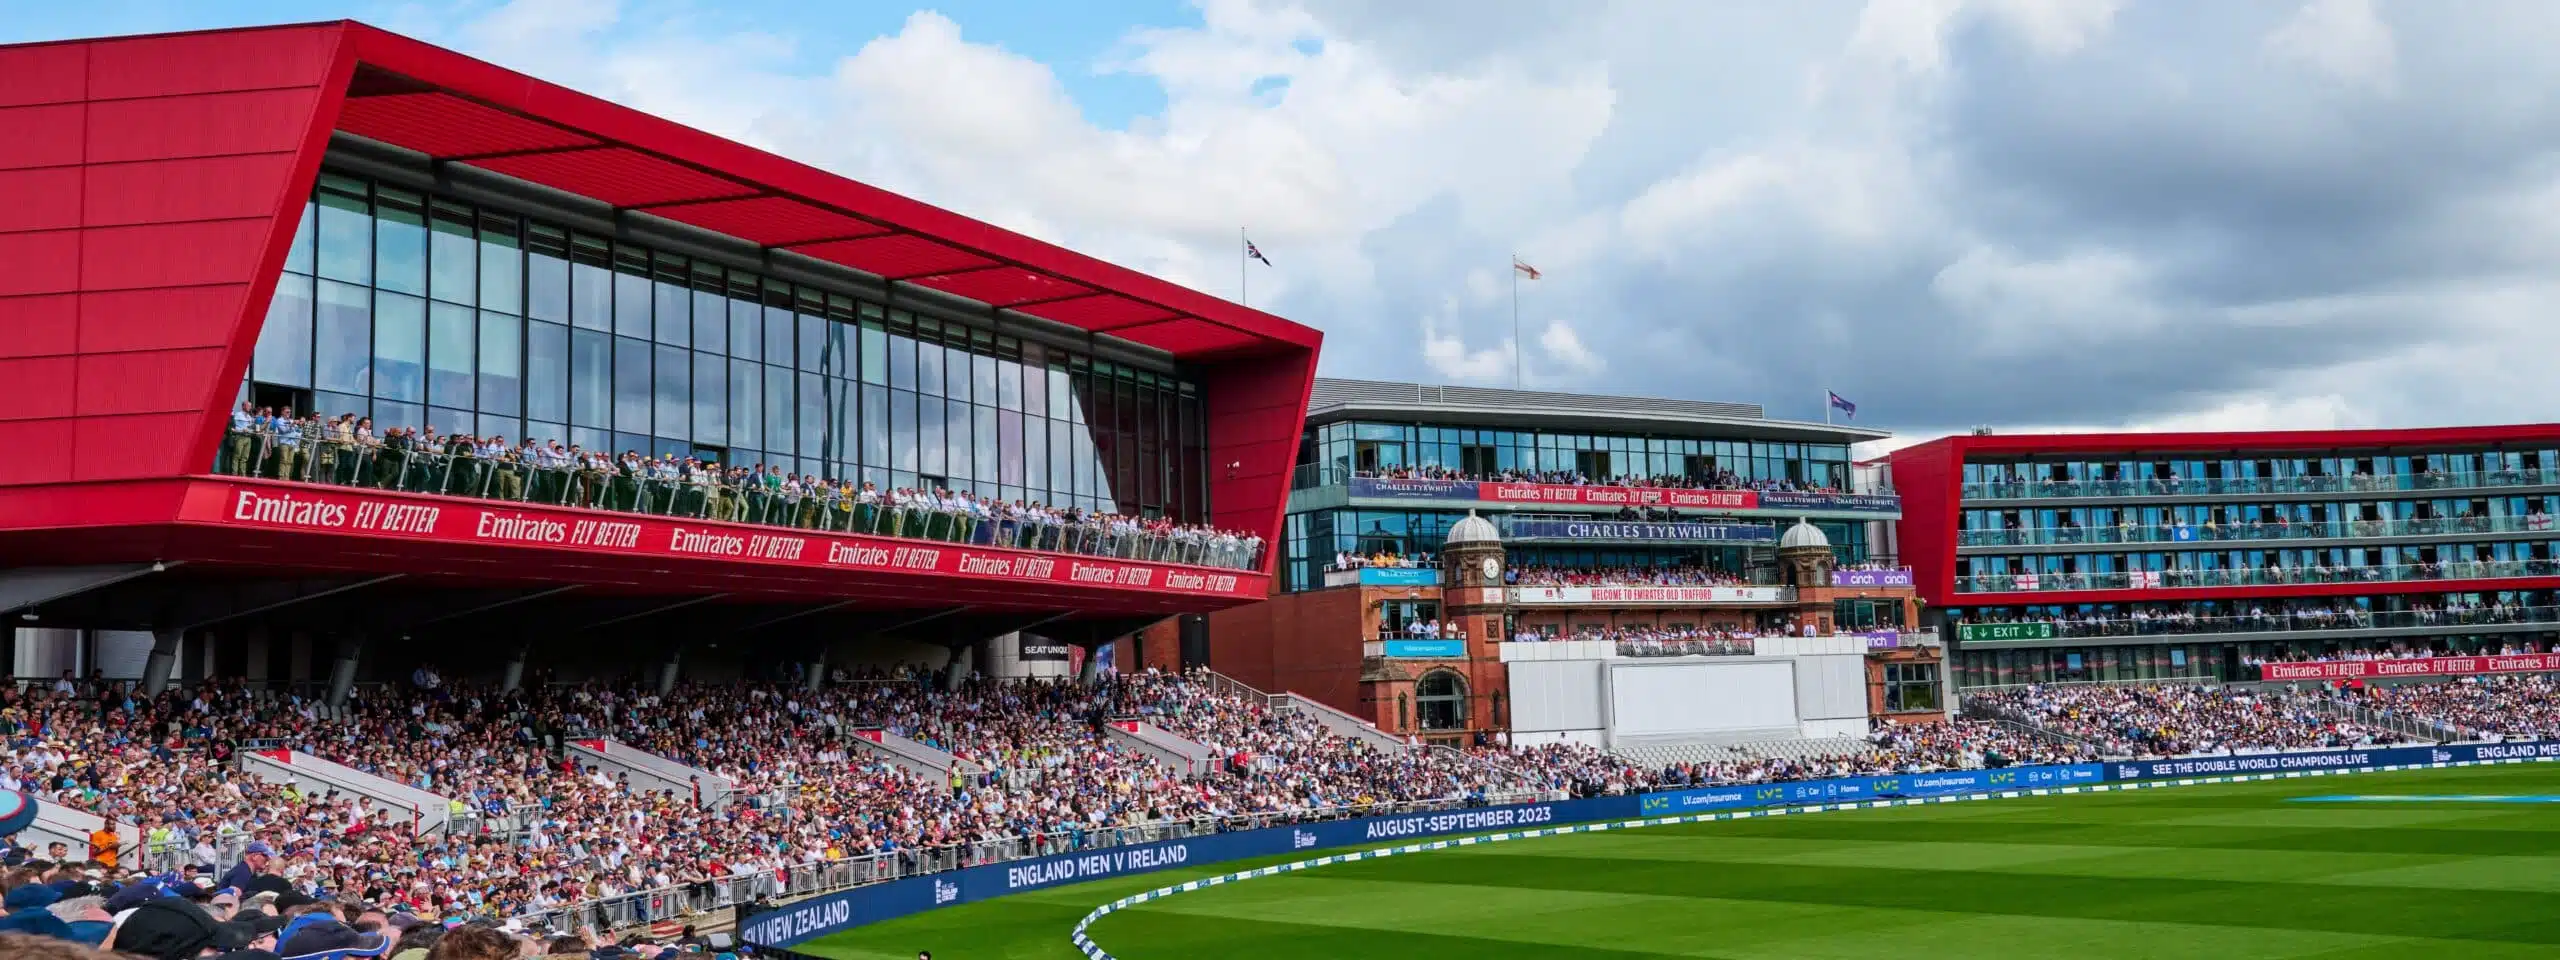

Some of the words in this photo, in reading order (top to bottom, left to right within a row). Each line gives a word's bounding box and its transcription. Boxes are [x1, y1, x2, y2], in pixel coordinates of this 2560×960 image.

[1498, 486, 1540, 500] Emirates
[1543, 488, 1554, 500] FLY
[1555, 488, 1577, 501] BETTER
[1586, 489, 1627, 502] Emirates
[1629, 490, 1640, 502] FLY
[1671, 492, 1709, 505] Emirates
[1722, 494, 1742, 506] BETTER
[234, 490, 347, 527] Emirates
[352, 501, 384, 529] FLY
[381, 504, 440, 533] BETTER
[476, 511, 567, 543] Emirates
[570, 519, 598, 545] FLY
[594, 522, 641, 548] BETTER
[1567, 524, 1640, 538] CHARLES
[1646, 525, 1728, 539] TYRWHITT
[670, 527, 744, 556] Emirates
[746, 534, 769, 557] FLY
[765, 536, 805, 560] BETTER
[828, 541, 888, 566] Emirates
[891, 547, 908, 567] FLY
[906, 548, 940, 570] BETTER
[958, 552, 1011, 576] Emirates
[1012, 556, 1029, 577] FLY
[1025, 558, 1055, 579] BETTER
[1070, 562, 1115, 584] Emirates
[1116, 566, 1129, 584] FLY
[1127, 567, 1152, 586] BETTER
[1166, 570, 1204, 590] Emirates
[1205, 574, 1218, 591] FLY
[1215, 575, 1237, 592] BETTER
[1850, 574, 1875, 584] cinch
[1884, 574, 1908, 584] cinch
[1591, 589, 1622, 601] WELCOME
[1623, 589, 1632, 601] TO
[1633, 589, 1665, 601] EMIRATES
[1666, 589, 1679, 601] OLD
[1680, 589, 1712, 601] TRAFFORD
[1993, 626, 2020, 638] EXIT
[1868, 635, 1887, 647] inch
[1024, 646, 1047, 654] SEAT
[2272, 665, 2322, 678] Emirates
[2325, 664, 2338, 676] FLY
[2339, 662, 2365, 676] BETTER
[2377, 661, 2429, 675] Emirates
[2433, 660, 2445, 672] FLY
[2447, 659, 2476, 672] BETTER
[2488, 657, 2542, 670] Emirates
[2546, 655, 2560, 668] FLY
[2476, 745, 2536, 759] ENGLAND
[2539, 743, 2560, 756] ME
[2152, 763, 2172, 775] SEE
[2174, 762, 2194, 774] THE
[2195, 760, 2236, 772] DOUBLE
[2239, 758, 2278, 770] WORLD
[2280, 755, 2343, 769] CHAMPIONS
[2345, 753, 2369, 765] LIVE
[1914, 776, 1975, 788] LV.com/insurance
[1682, 793, 1742, 806] LV.com/insurance
[1366, 809, 1514, 839] AUGUST-SEPTEMBER
[1517, 806, 1552, 824] 2023
[1009, 859, 1074, 889] ENGLAND
[1078, 853, 1110, 877] MEN
[1114, 852, 1125, 872] V
[1128, 844, 1187, 870] IRELAND
[757, 921, 765, 946] V
[766, 913, 793, 946] NEW
[794, 899, 850, 936] ZEALAND
